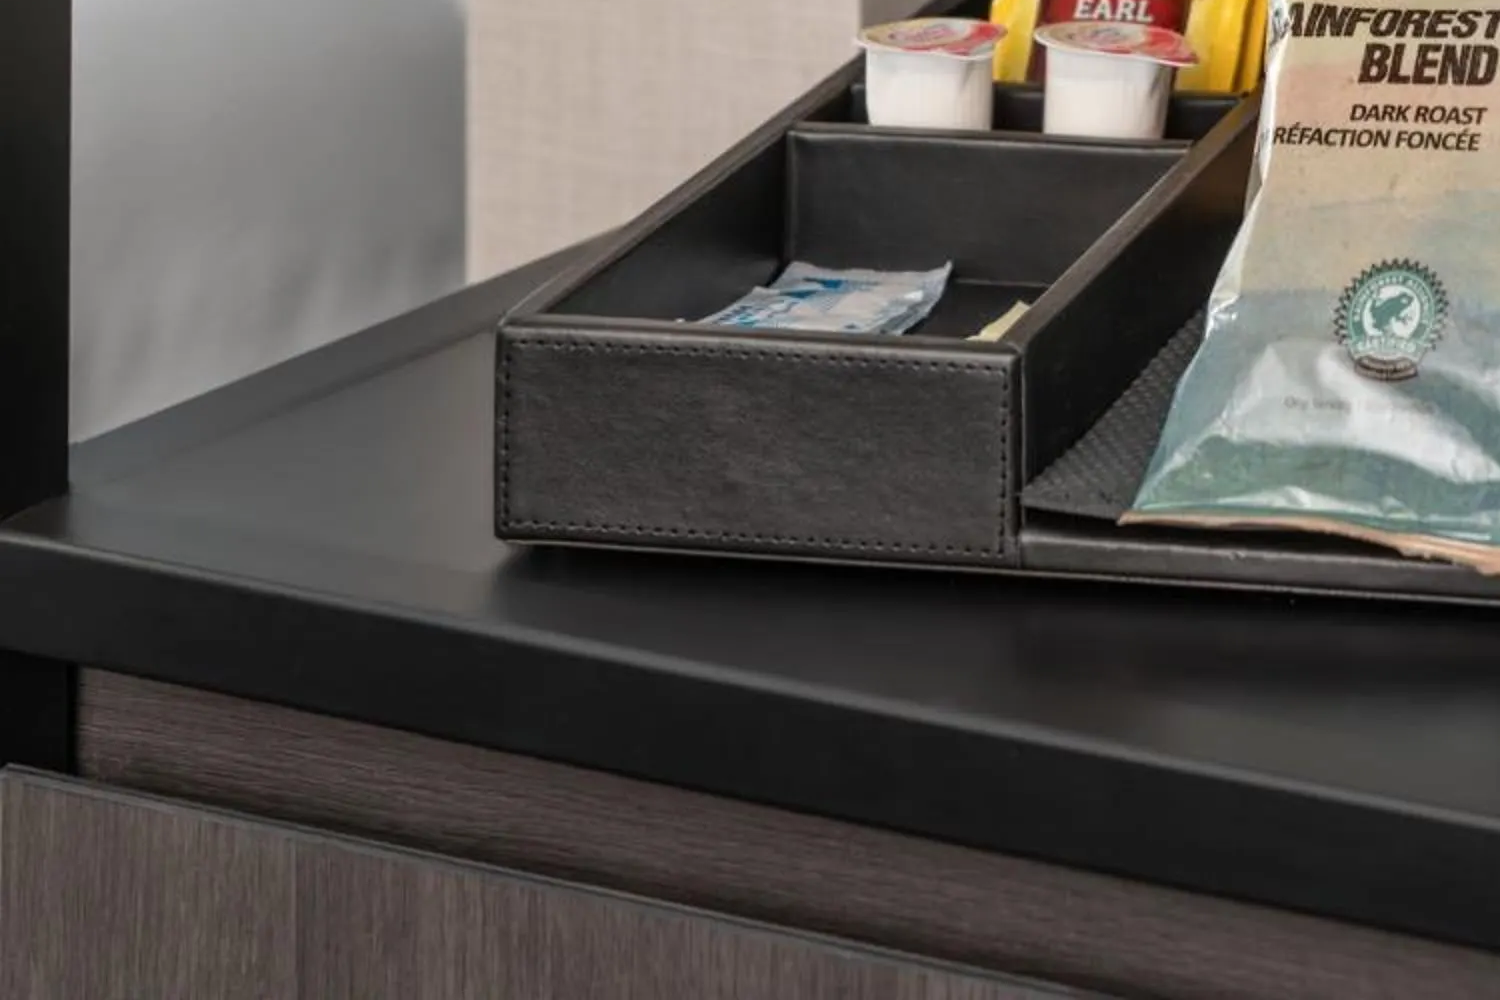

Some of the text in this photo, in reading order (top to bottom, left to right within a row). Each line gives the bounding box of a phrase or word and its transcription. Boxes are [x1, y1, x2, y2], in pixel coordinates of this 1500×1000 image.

[1358, 42, 1499, 86] BLEND
[1350, 103, 1487, 125] DARK ROAST
[1272, 121, 1481, 151] RÉFACTION FONCÉE
